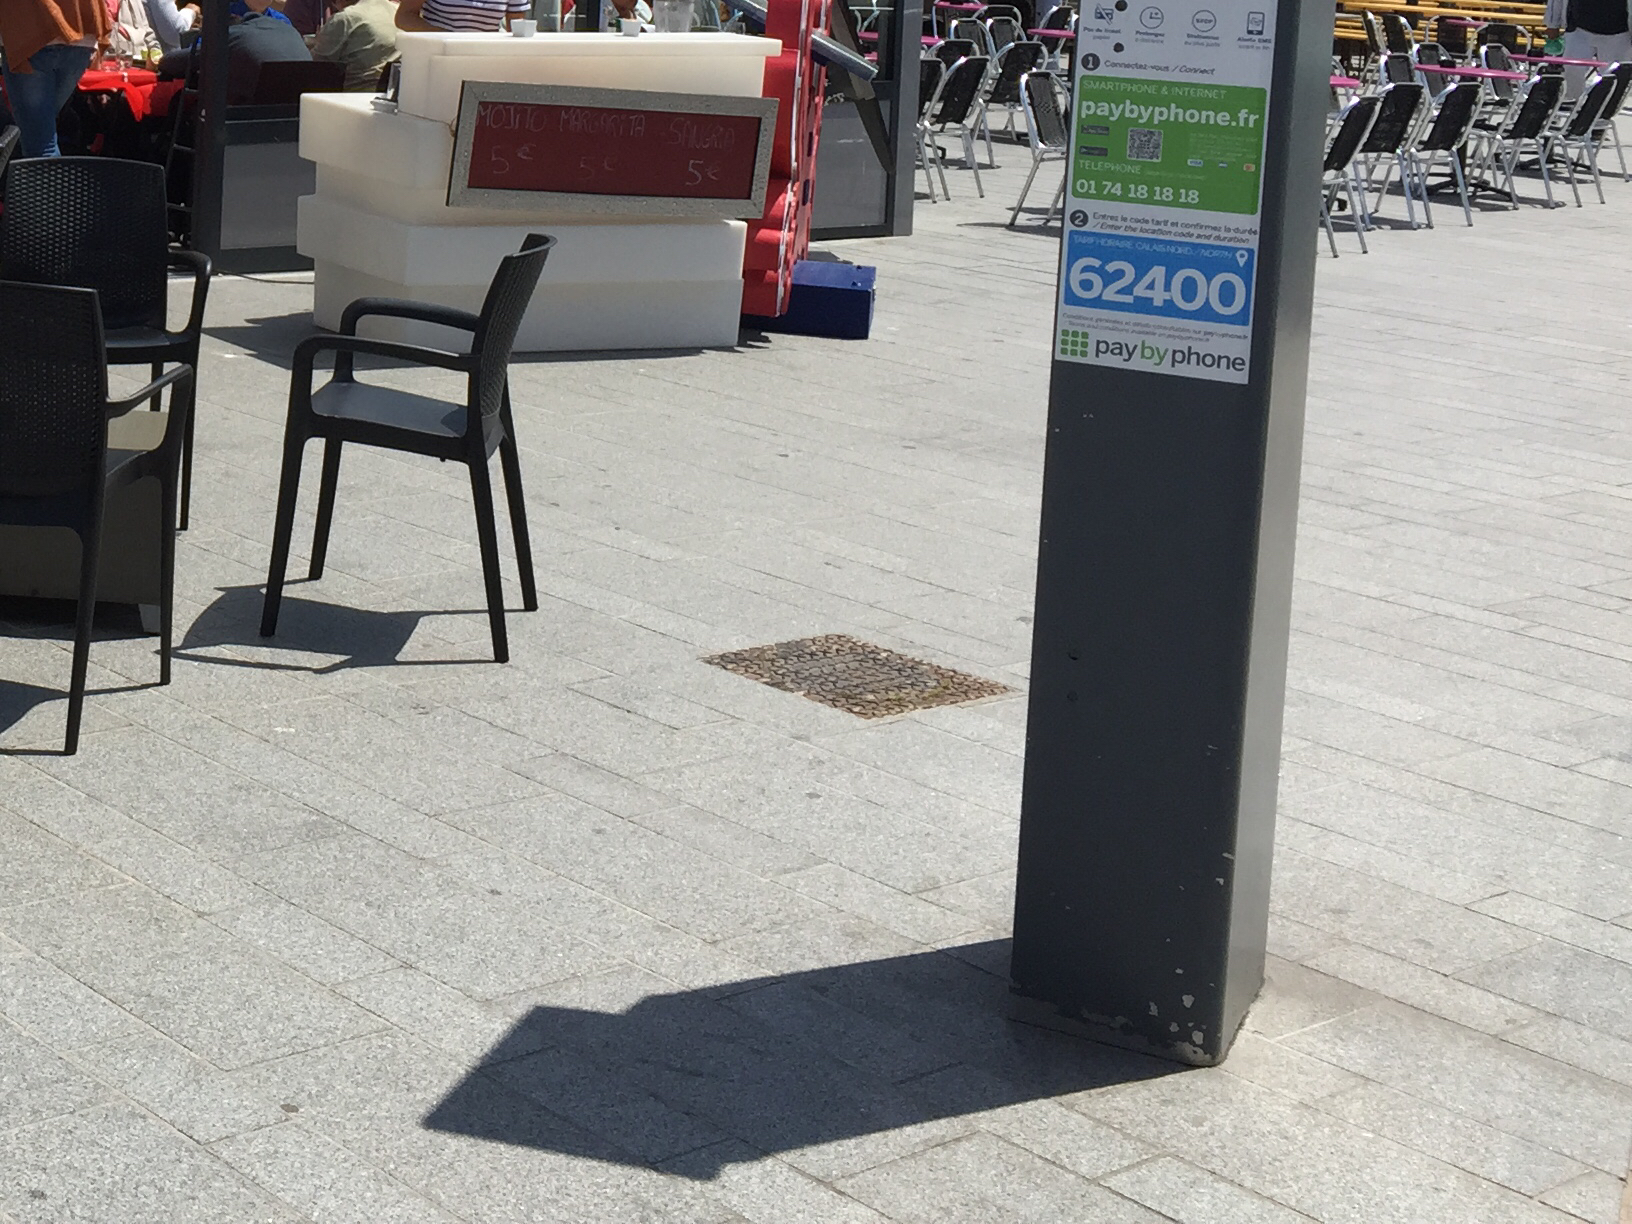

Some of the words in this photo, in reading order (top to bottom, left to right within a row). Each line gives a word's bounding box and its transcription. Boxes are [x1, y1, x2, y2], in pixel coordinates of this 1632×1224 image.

[1104, 59, 1170, 73] Connectez-vous
[1179, 65, 1216, 75] Connect
[1083, 80, 1158, 95] SMARTPHONE
[1161, 86, 1168, 95] &
[1171, 86, 1227, 99] INTERNET
[477, 104, 545, 132] MOJITO
[559, 109, 646, 137] MARGARITA
[1080, 99, 1259, 128] paybyphone.fr
[1076, 179, 1097, 194] 01
[1101, 181, 1122, 196] 74
[1128, 184, 1148, 199] 18
[1153, 186, 1174, 202] 18
[1178, 189, 1199, 204] 18
[1120, 214, 1128, 223] le
[1129, 216, 1151, 225] code
[1100, 222, 1123, 232] Enter
[1124, 224, 1138, 233] the
[1139, 225, 1173, 237] location
[1173, 230, 1194, 239] code
[1195, 232, 1212, 241] and
[1213, 233, 1250, 244] duration
[1069, 256, 1247, 315] 62400
